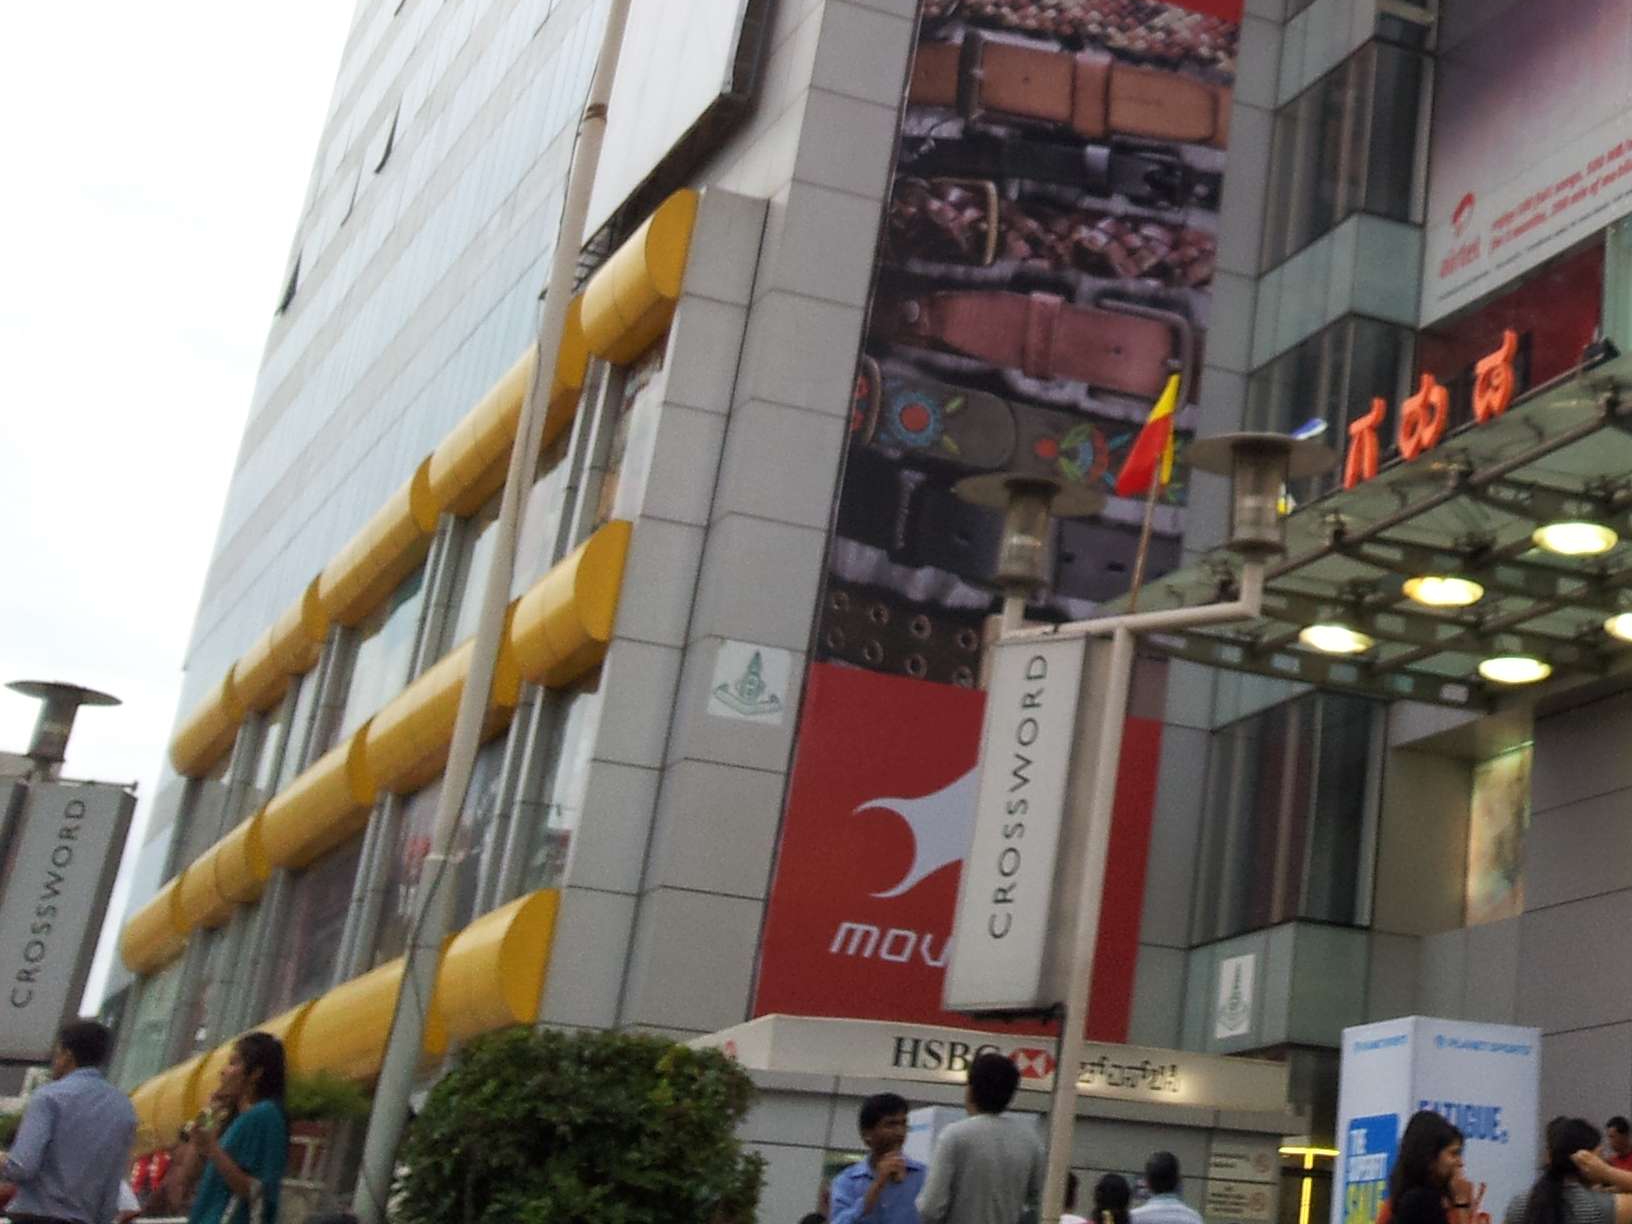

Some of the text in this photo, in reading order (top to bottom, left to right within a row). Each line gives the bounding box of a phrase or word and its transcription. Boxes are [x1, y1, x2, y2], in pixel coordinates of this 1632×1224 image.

[986, 653, 1049, 940] CROSSWORD
[9, 798, 87, 1009] CROSSWORD
[891, 1035, 1001, 1072] HSB
